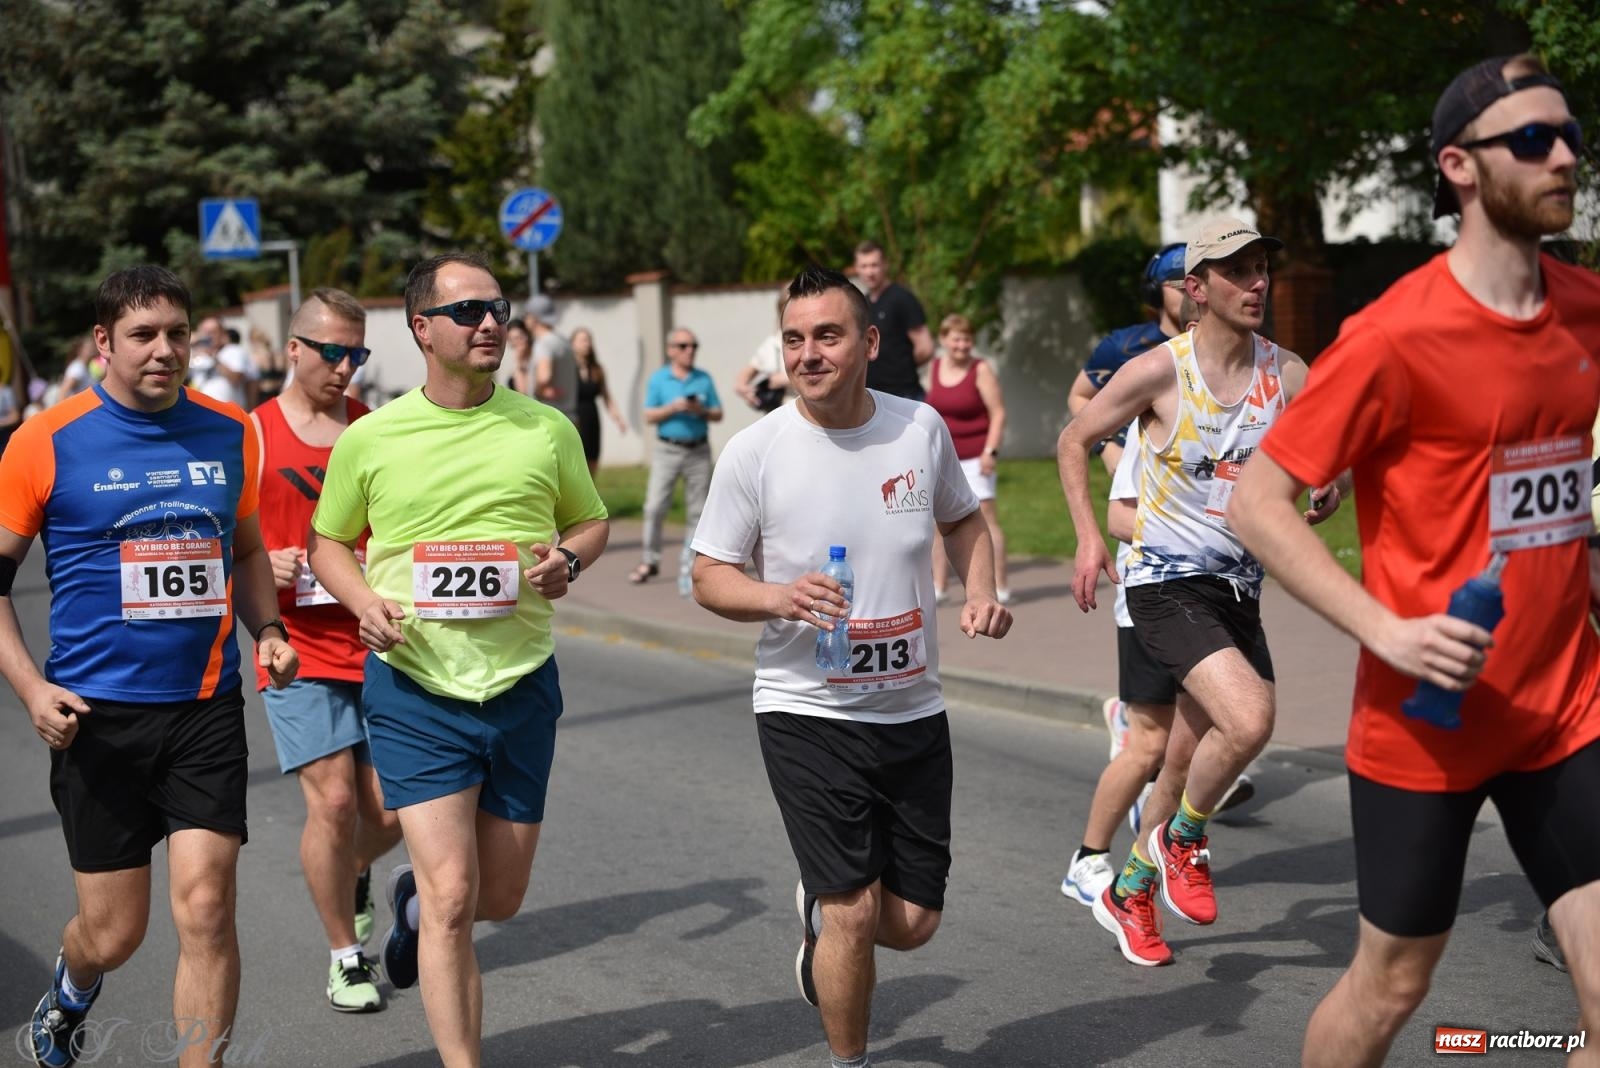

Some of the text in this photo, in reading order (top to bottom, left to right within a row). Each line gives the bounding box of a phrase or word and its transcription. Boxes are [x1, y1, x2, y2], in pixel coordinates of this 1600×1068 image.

[94, 482, 140, 492] Ensinger
[902, 490, 928, 507] KNS
[1511, 469, 1580, 520] 203
[113, 504, 157, 529] Heilbronner
[186, 541, 211, 549] GRANIC
[144, 564, 208, 598] 165
[432, 566, 501, 597] 226
[891, 614, 913, 626] GRANIC
[852, 639, 909, 673] 213
